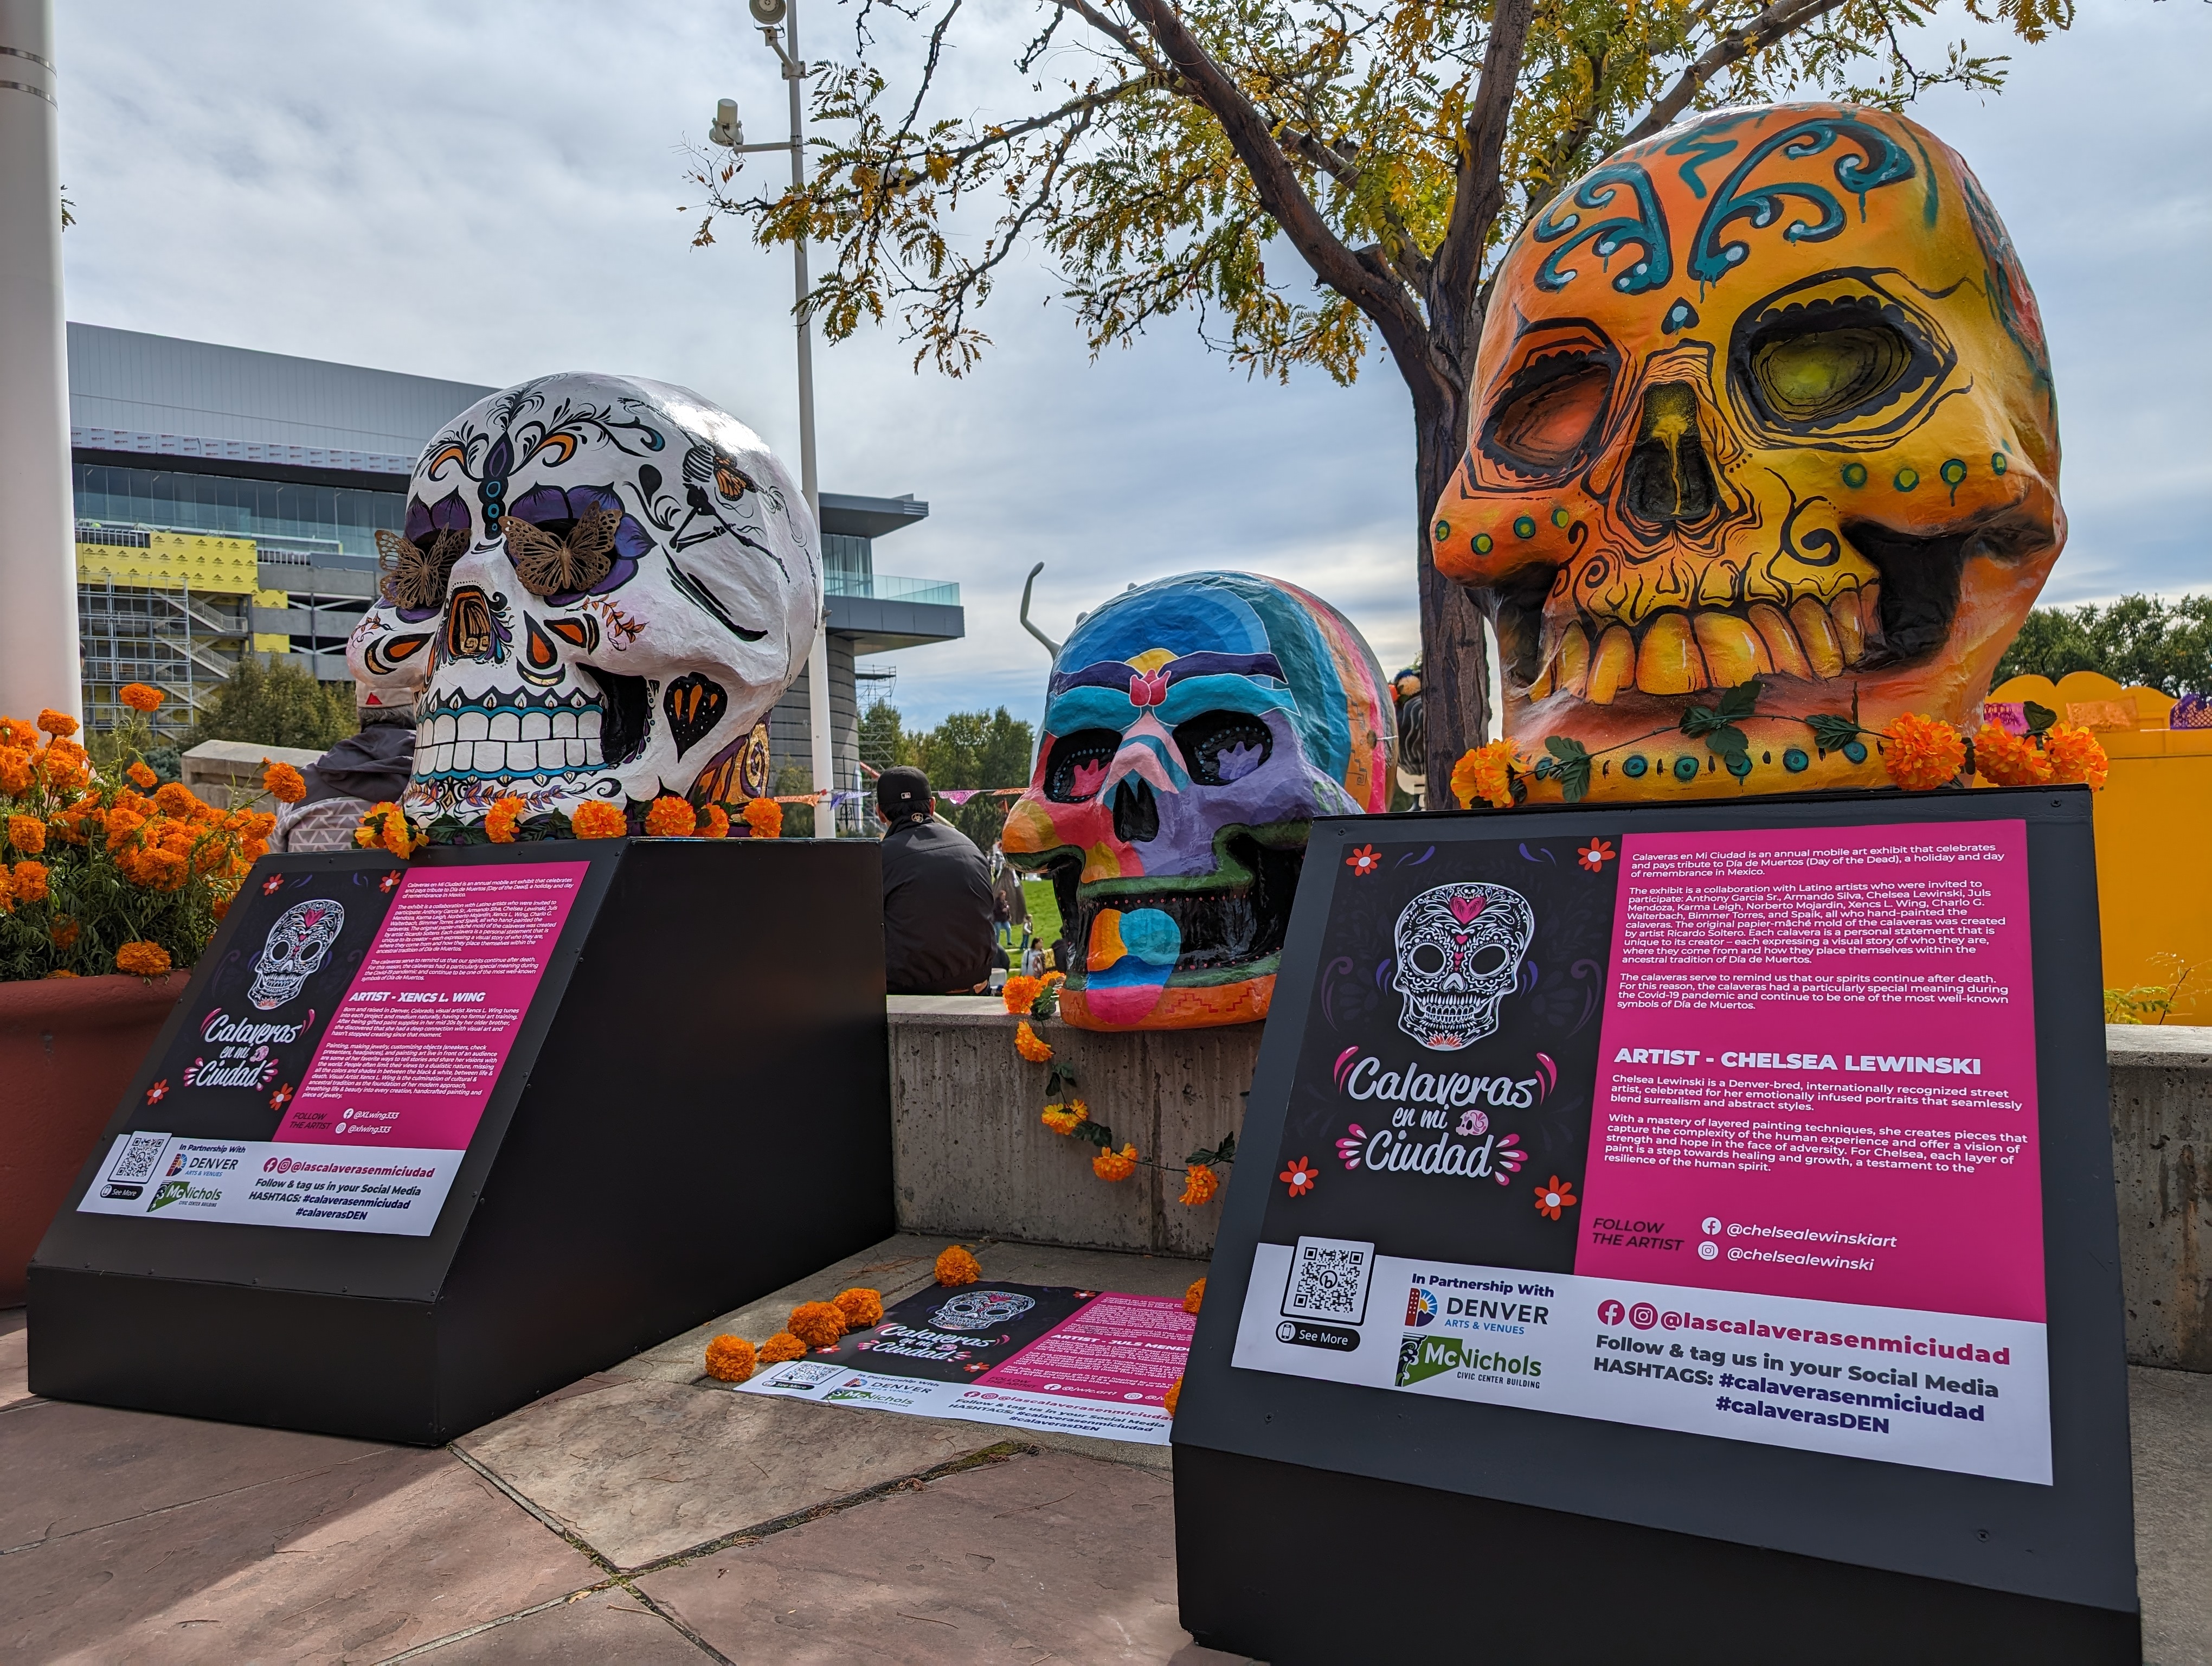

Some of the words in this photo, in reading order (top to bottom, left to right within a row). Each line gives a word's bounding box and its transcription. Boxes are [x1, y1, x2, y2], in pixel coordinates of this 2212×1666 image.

[1631, 861, 1650, 869] and
[1652, 862, 1675, 870] pays
[1676, 860, 1711, 868] tribute
[1725, 859, 1742, 867] Día
[1744, 858, 1759, 867] de
[1760, 858, 1804, 867] Muertos
[1805, 857, 1831, 867] (Day
[1831, 856, 1844, 864] of
[1844, 856, 1864, 864] the
[1866, 854, 1902, 864] Dead),
[1913, 853, 1956, 862] holiday
[1957, 852, 1980, 861] and
[1982, 851, 2005, 861] day
[1632, 853, 1679, 861] Calaveras
[1695, 851, 1708, 860] Mi
[1709, 850, 1746, 859] Ciudad
[1748, 850, 1757, 858] is
[1773, 849, 1810, 857] annual
[1812, 848, 1850, 857] mobile
[1869, 845, 1908, 855] exhibit
[1909, 844, 1934, 853] that
[1935, 843, 1996, 853] celebrates
[1630, 869, 1641, 877] of
[1642, 869, 1713, 877] remembrance
[1715, 868, 1725, 876] in
[1727, 868, 1765, 876] Mexico.
[348, 991, 391, 1002] ARTIST
[396, 991, 439, 1003] XENCS
[438, 992, 449, 1002] L.
[452, 991, 486, 1002] WING
[204, 1014, 303, 1045] Calaveras
[219, 1045, 236, 1059] en
[233, 1043, 254, 1059] mi
[1613, 1047, 1700, 1066] ARTIST
[1720, 1051, 1838, 1070] CHELSEA
[1844, 1054, 1981, 1075] LEWINSKI
[196, 1060, 267, 1087] Ciudad
[1348, 1056, 1538, 1108] Calaveras
[292, 1112, 327, 1120] FOLLOW
[352, 1110, 400, 1120] @XLwing333
[1392, 1107, 1416, 1127] en
[1420, 1104, 1448, 1130] mi
[288, 1120, 306, 1129] THE
[303, 1121, 332, 1130] ARTIST
[178, 1143, 187, 1151] In
[187, 1144, 228, 1154] Partnership
[228, 1145, 246, 1153] With
[1365, 1129, 1493, 1178] Ciudad
[188, 1157, 239, 1170] DENVER
[290, 1161, 436, 1178] @lascalaverasenmiciudad
[111, 1188, 123, 1196] See
[166, 1184, 222, 1201] McNichols
[254, 1177, 287, 1188] Follow
[286, 1180, 295, 1188] &
[295, 1180, 313, 1191] tag
[313, 1182, 326, 1190] us
[335, 1184, 361, 1194] your
[359, 1183, 392, 1194] Social
[390, 1185, 421, 1196] Media
[247, 1190, 302, 1203] HASHTAGS:
[301, 1194, 411, 1209] #calaverasenmiciudad
[295, 1207, 369, 1220] #calaverasDEN
[1592, 1217, 1665, 1234] FOLLOW
[1726, 1222, 1898, 1247] @chelsealewinskiart
[1593, 1232, 1624, 1246] THE
[1625, 1235, 1685, 1251] ARTIST
[1727, 1247, 1875, 1271] @chelsealewinski
[1411, 1272, 1425, 1285] In
[1428, 1274, 1513, 1296] Partnership
[1517, 1283, 1554, 1298] With
[1445, 1296, 1548, 1325] DENVER
[1444, 1318, 1470, 1329] ARTS
[1472, 1321, 1480, 1330] &
[1483, 1322, 1525, 1335] VENUES
[880, 1325, 996, 1347] Calaveras
[1050, 1334, 1101, 1343] ARTIST
[1298, 1329, 1318, 1341] See
[1320, 1332, 1348, 1345] More
[1660, 1310, 2010, 1366] @lascalaverasenmiciudad
[872, 1342, 957, 1360] Ciudad
[1424, 1343, 1541, 1377] McNichols
[1596, 1334, 1664, 1355] Follow
[1668, 1343, 1684, 1359] &
[1689, 1345, 1726, 1367] tag
[1732, 1353, 1757, 1367] us
[1763, 1357, 1784, 1372] in
[1789, 1360, 1842, 1379] your
[1847, 1365, 1918, 1388] Social
[1925, 1374, 1999, 1398] Media
[866, 1375, 917, 1383] Partnership
[870, 1381, 933, 1394] DENVER
[1456, 1370, 1475, 1380] CIVIC
[1477, 1373, 1503, 1385] CENTER
[1506, 1377, 1540, 1389] BUILDING
[1593, 1356, 1714, 1386] HASHTAGS:
[1718, 1372, 1984, 1421] #calaverasenmiciudad
[846, 1391, 915, 1406] McNichols
[947, 1403, 1015, 1414] HASHTAGS:
[1015, 1411, 1154, 1432] #calaverasenmiciudad
[1008, 1415, 1101, 1431] #calaverasDEN
[1088, 1414, 1127, 1422] Social
[1127, 1419, 1165, 1428] Media
[1715, 1395, 1889, 1434] #calaverasDEN
